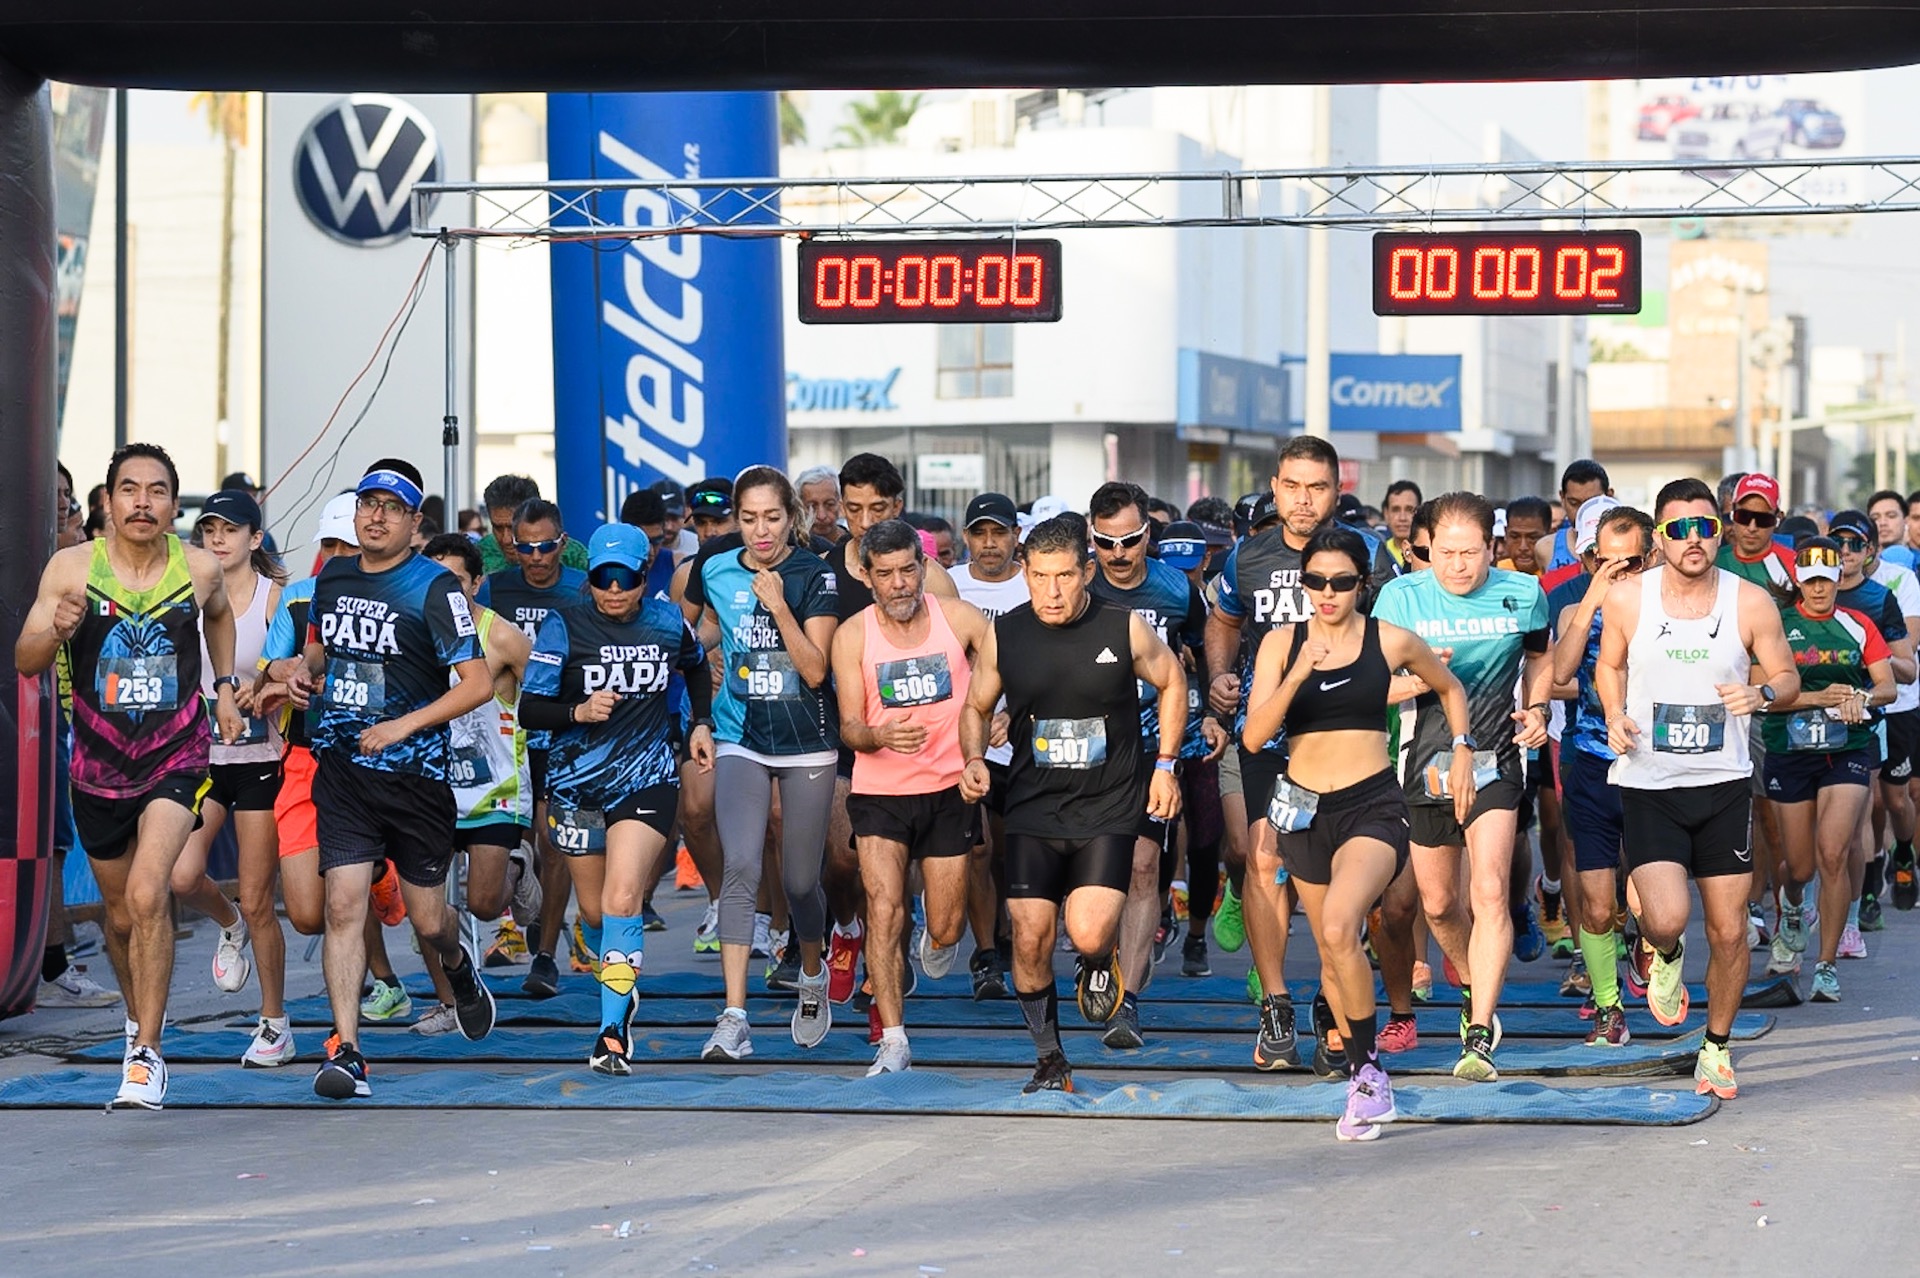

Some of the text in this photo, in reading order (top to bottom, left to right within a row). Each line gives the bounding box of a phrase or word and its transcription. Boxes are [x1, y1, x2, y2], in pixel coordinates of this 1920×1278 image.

[815, 256, 1043, 308] 00:00:00
[1331, 375, 1455, 408] Comex
[335, 595, 389, 620] SUPER
[1415, 616, 1521, 637] HALCONES
[600, 643, 660, 664] SUPER
[1665, 649, 1710, 660] VELOZ
[118, 677, 163, 704] 253
[332, 678, 369, 707] 328
[747, 670, 784, 695] 159
[893, 673, 938, 702] 506
[1667, 723, 1710, 748] 520
[1808, 723, 1826, 743] 11
[1048, 738, 1089, 763] 507
[556, 823, 590, 849] 327
